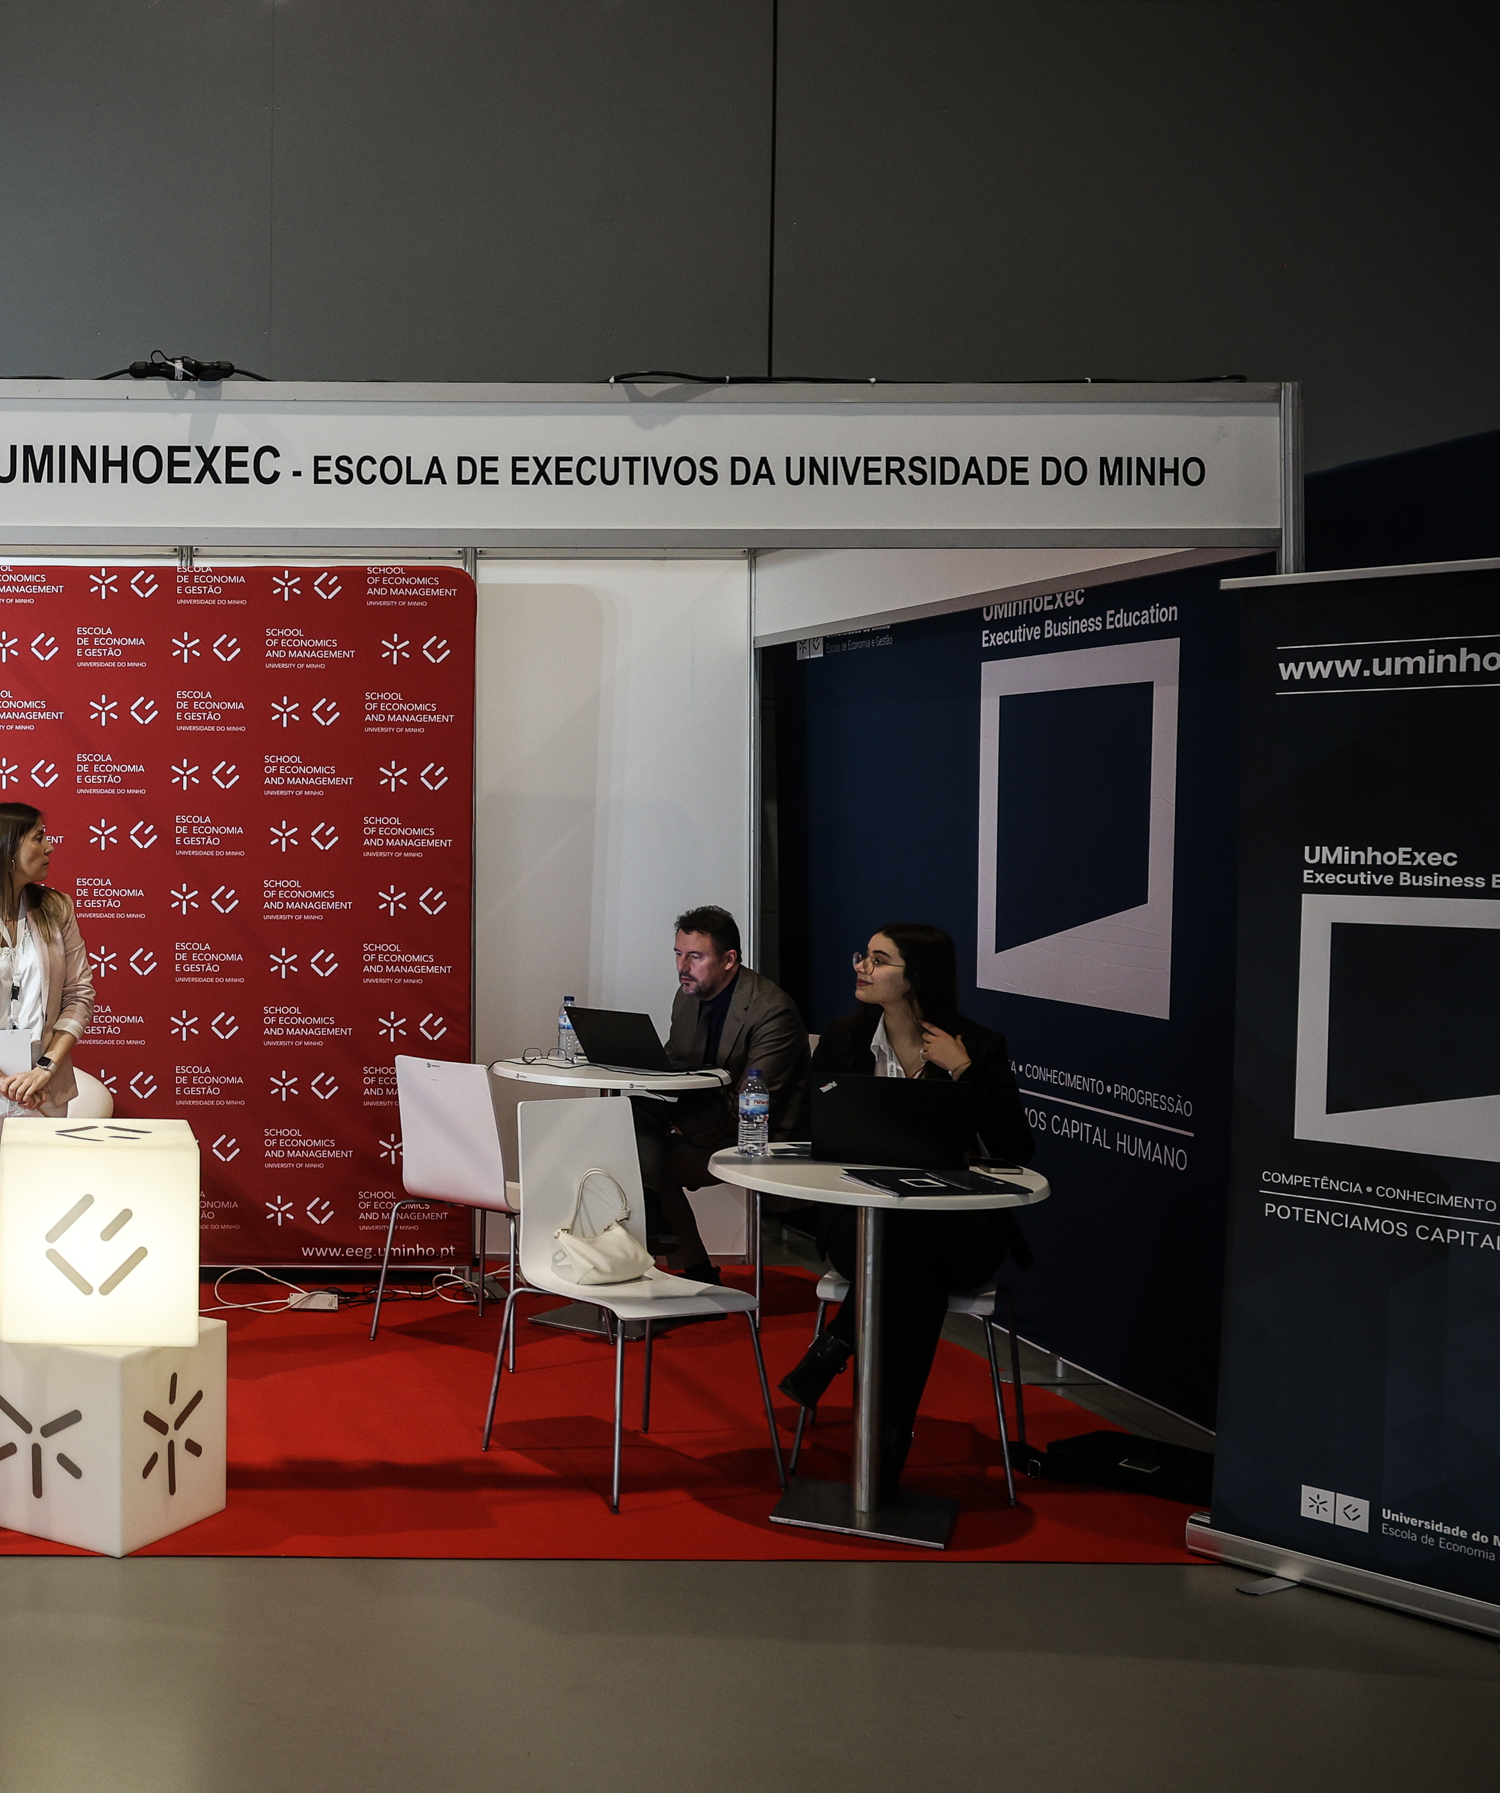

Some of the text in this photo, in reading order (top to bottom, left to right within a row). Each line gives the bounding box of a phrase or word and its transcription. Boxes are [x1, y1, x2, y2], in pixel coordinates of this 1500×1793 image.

[314, 455, 447, 485] ESCOLA
[457, 456, 499, 485] DE
[512, 456, 718, 485] EXECUTIVOS
[731, 457, 775, 485] DA
[786, 456, 1029, 485] UNIVERSIDADE
[1042, 456, 1087, 486] DO
[1100, 457, 1205, 486] MINHO
[982, 603, 1177, 647] Executive Business Education
[365, 692, 403, 700] SCHOOL
[381, 703, 436, 711] ECONOMICS
[365, 714, 454, 722] AND MANAGEMENT
[1305, 846, 1457, 866] UMinhoExec
[1304, 870, 1393, 885] Executive
[1400, 872, 1485, 887] Business
[1026, 1064, 1104, 1095] CONHECIMENTO
[1114, 1084, 1192, 1116] PROGRESSÃO
[1052, 1115, 1110, 1149] CAPITAL
[1117, 1132, 1187, 1170] HUMANO
[1262, 1171, 1497, 1213] COMPETÊNCIA CONHECIMENTO
[1264, 1202, 1409, 1238] POTENCIAMOS
[1382, 1508, 1488, 1543] Universidade do
[1382, 1523, 1496, 1561] Escola de Economia
